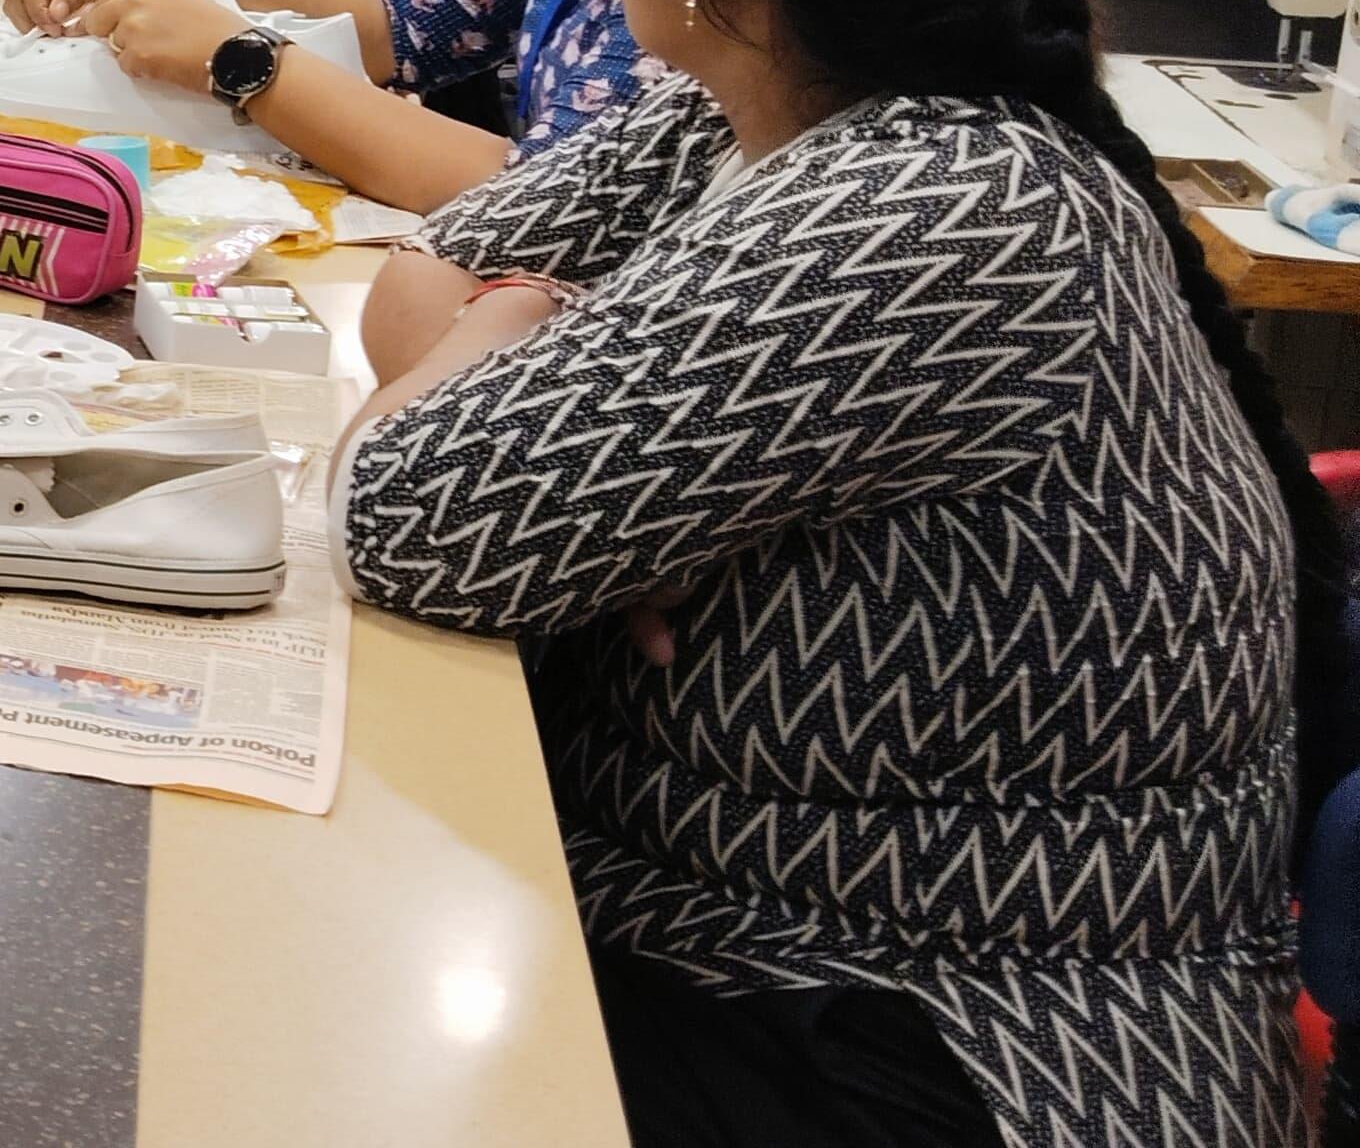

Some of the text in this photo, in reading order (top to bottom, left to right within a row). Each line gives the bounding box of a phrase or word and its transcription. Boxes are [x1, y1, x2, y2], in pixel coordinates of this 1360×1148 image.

[23, 712, 194, 748] Appeasement
[197, 737, 226, 748] of
[232, 738, 316, 769] Poison
